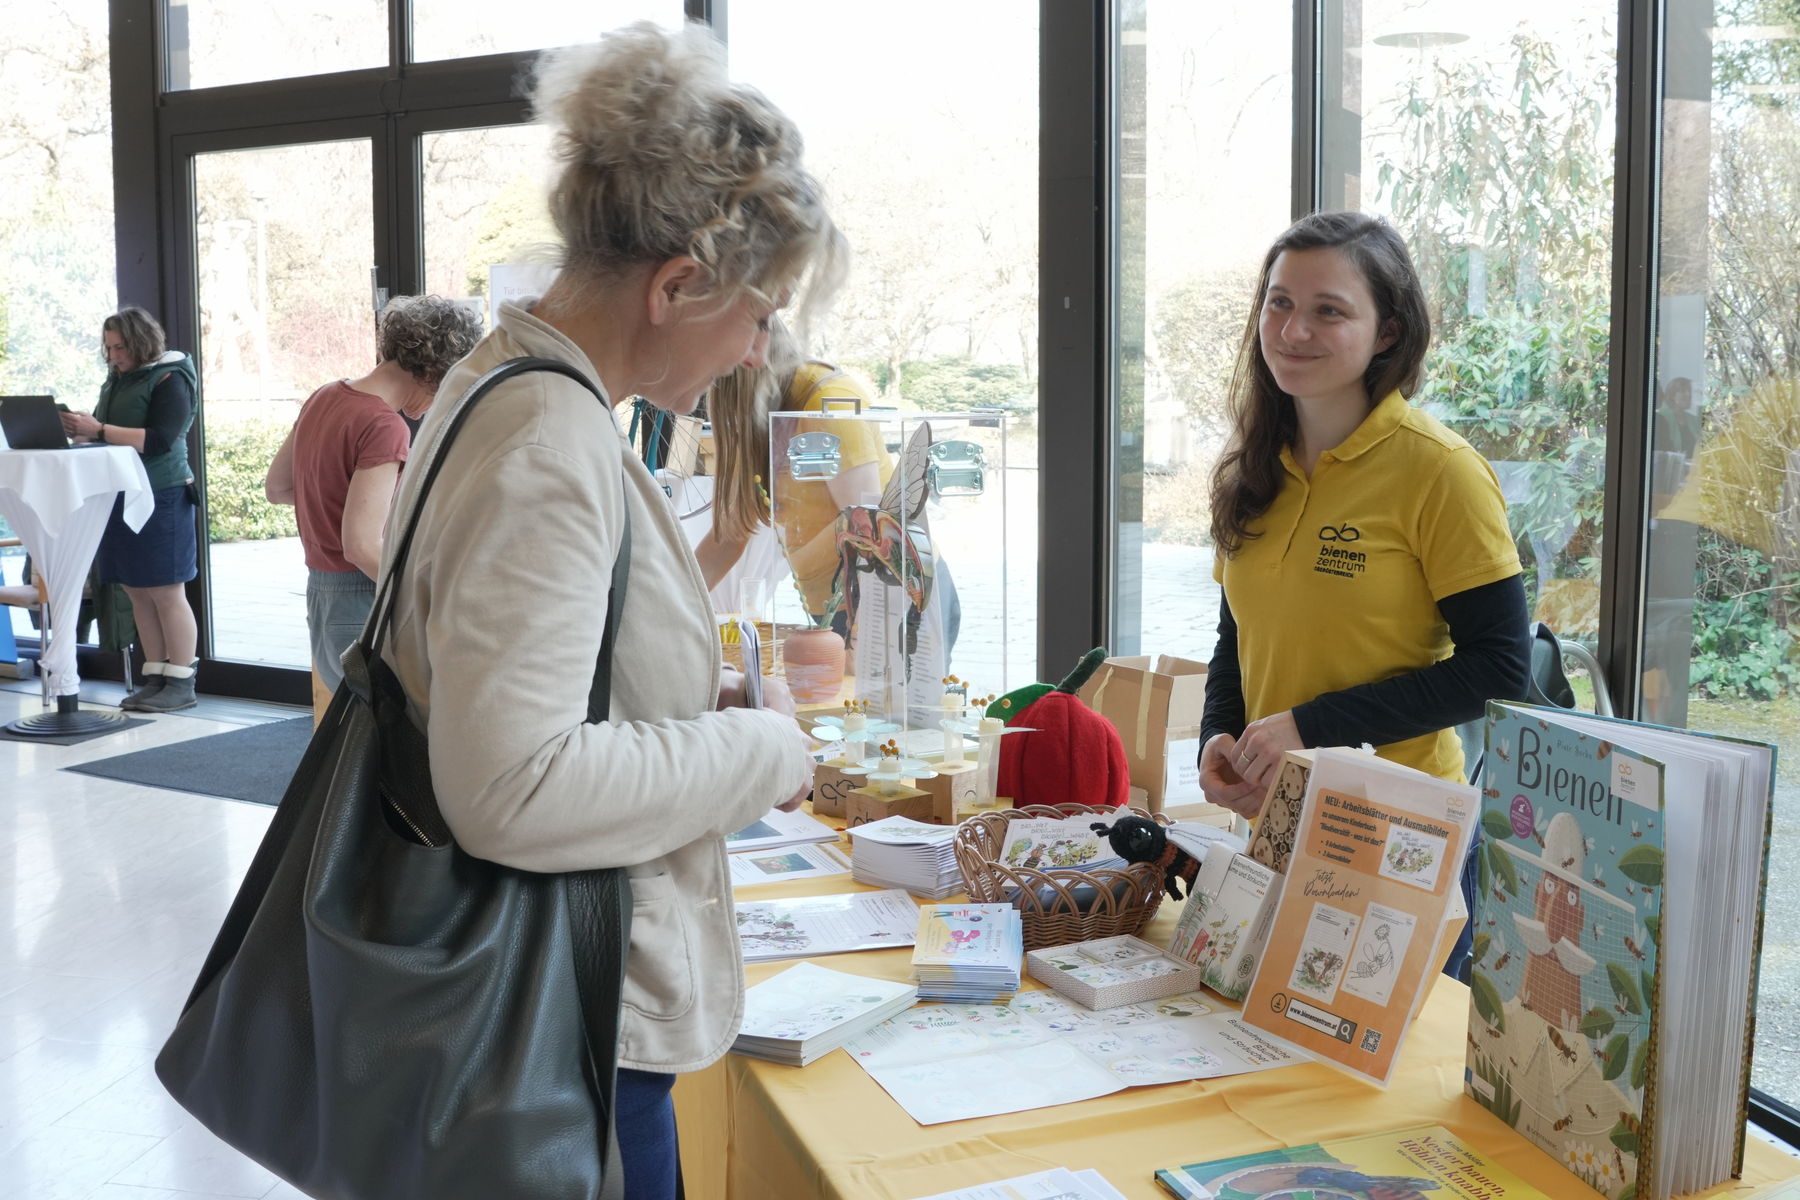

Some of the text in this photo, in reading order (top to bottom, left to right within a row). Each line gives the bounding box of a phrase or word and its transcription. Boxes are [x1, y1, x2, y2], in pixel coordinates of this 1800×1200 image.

[1316, 557, 1365, 573] zentrum
[1319, 545, 1366, 563] bienen
[1517, 726, 1622, 826] Bienen
[1325, 795, 1341, 808] NEU:
[1341, 800, 1388, 821] Arbeitsblätter
[1389, 815, 1402, 825] und
[1403, 818, 1449, 838] Ausmalbilder
[1349, 817, 1377, 832] Kinderbuch
[1233, 858, 1270, 881] Bienenfreundliche
[1238, 871, 1247, 879] und
[1398, 1139, 1492, 1200] Höhlen knabb
[1417, 1136, 1505, 1198] Nester bauen,
